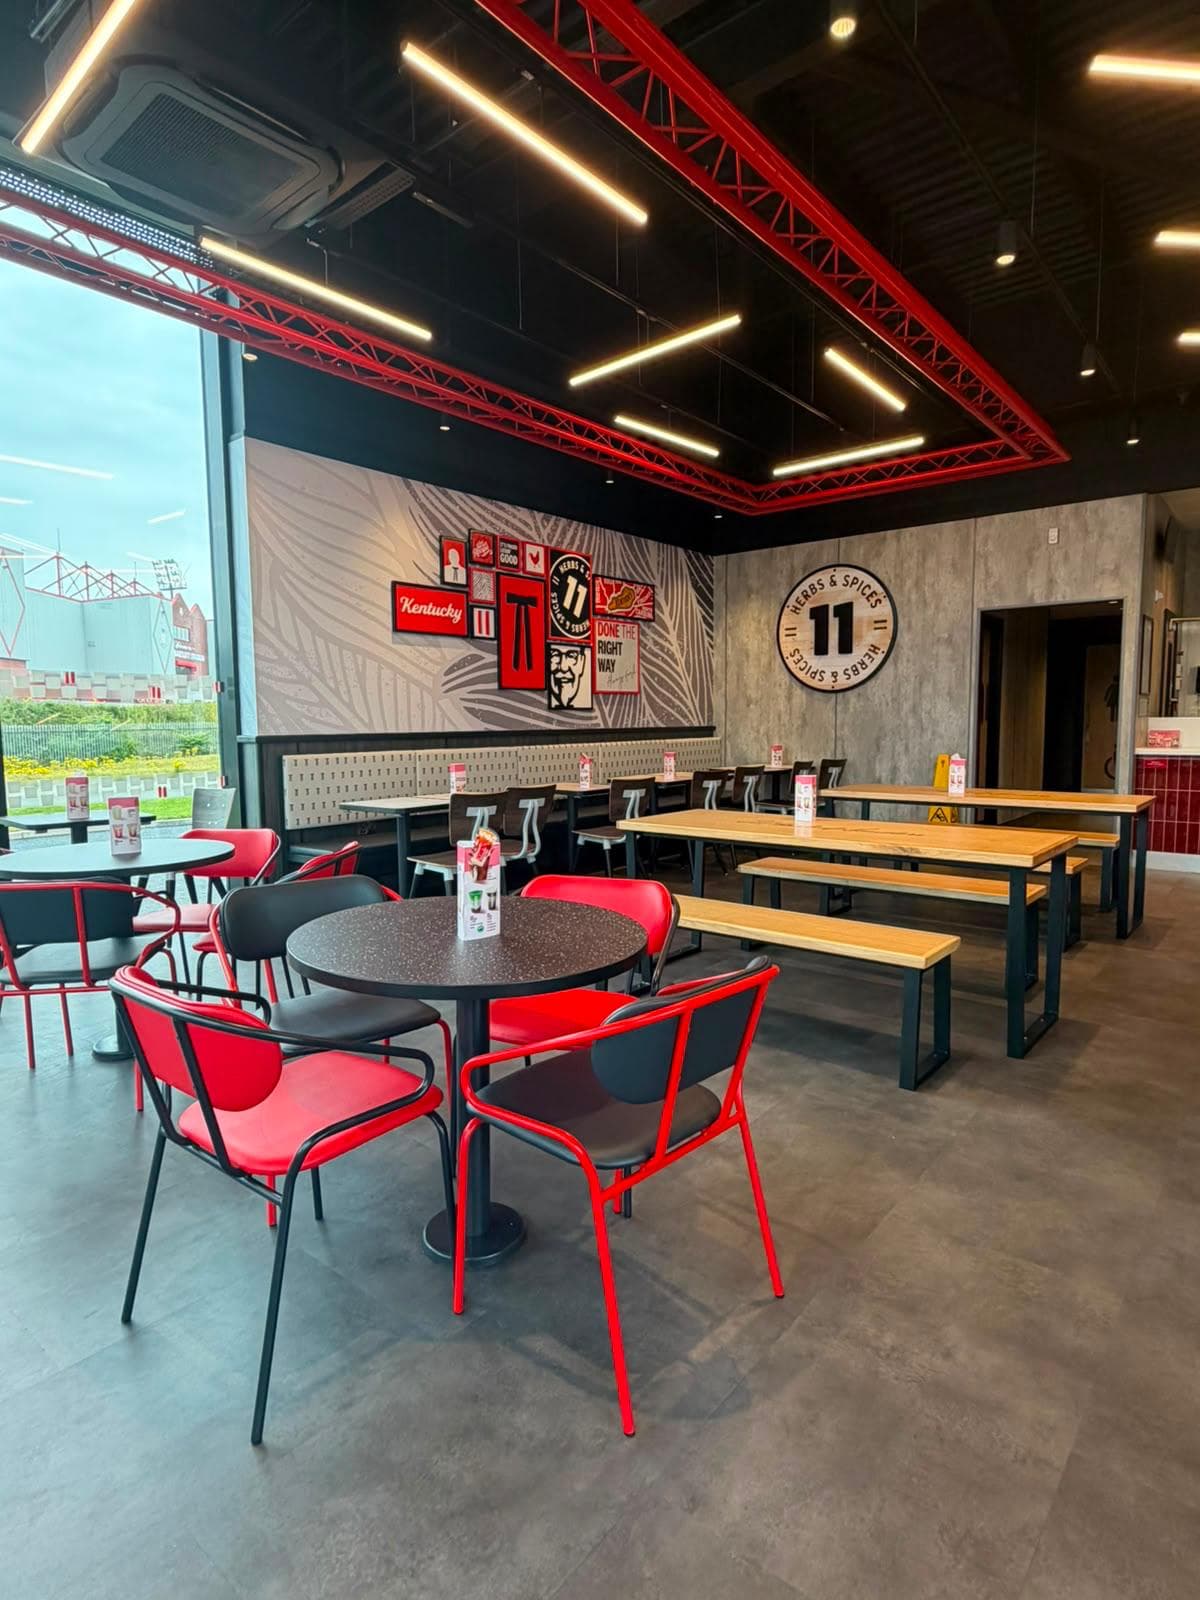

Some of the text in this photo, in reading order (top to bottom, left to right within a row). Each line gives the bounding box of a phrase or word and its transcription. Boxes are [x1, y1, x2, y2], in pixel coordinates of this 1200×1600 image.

[500, 553, 518, 566] GOOD
[563, 575, 588, 618] 11
[790, 574, 882, 615] HERBS & SPICES
[400, 596, 462, 624] Kentucky
[598, 622, 636, 640] DONE THE
[809, 601, 854, 656] 11
[598, 640, 623, 656] RIGHT
[598, 658, 616, 673] WAY
[789, 644, 881, 683] HERBS & SPICES
